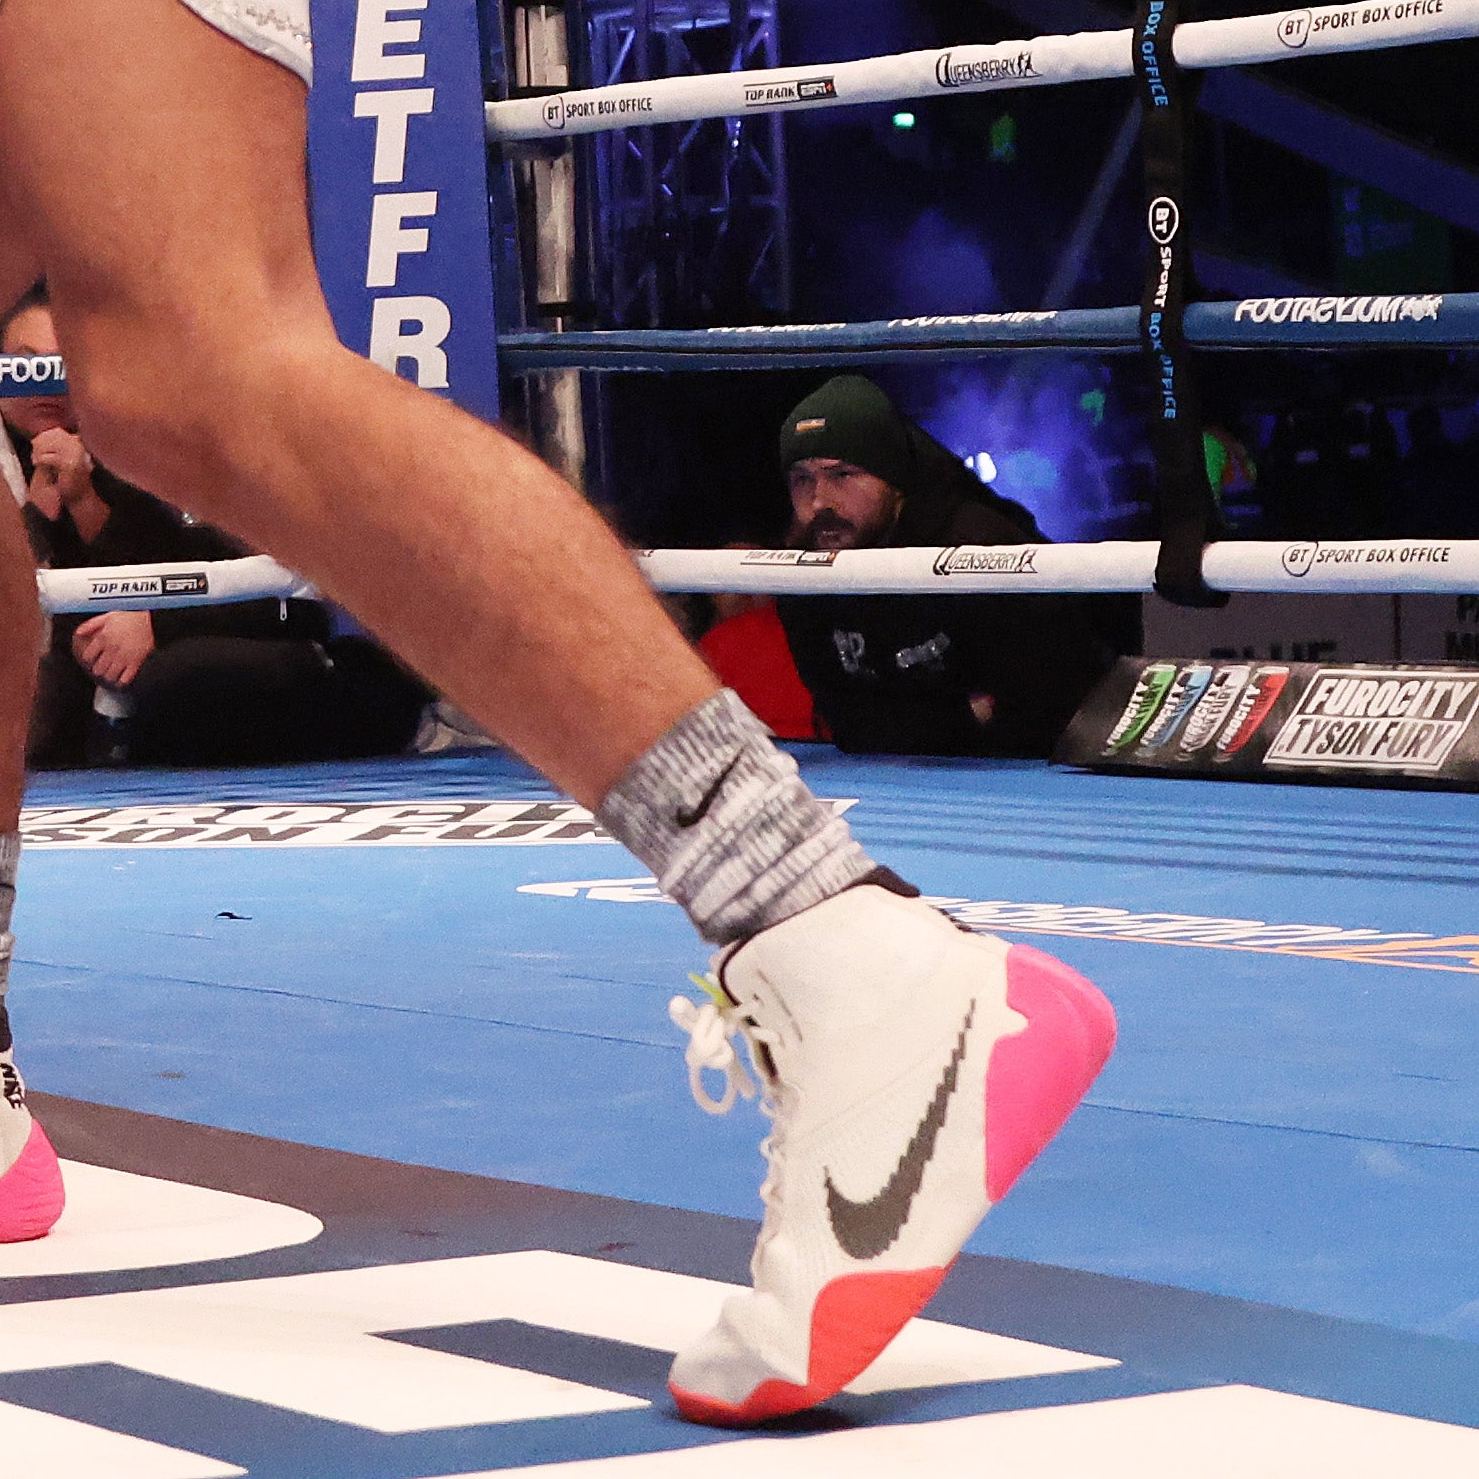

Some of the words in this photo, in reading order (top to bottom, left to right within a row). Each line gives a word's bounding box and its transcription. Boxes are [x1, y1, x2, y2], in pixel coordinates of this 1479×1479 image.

[1142, 0, 1164, 37] BOX
[1284, 19, 1304, 36] BT
[1312, 10, 1357, 33] SPORT
[1361, 4, 1392, 27] BOX
[935, 53, 1016, 88] QUEENSBERRY
[1142, 41, 1169, 107] OFFICE
[546, 105, 560, 122] BT
[566, 100, 595, 120] SPORT
[598, 100, 618, 117] BOX
[619, 97, 653, 116] OFFICE
[1155, 207, 1170, 234] BT
[1154, 246, 1172, 309] SPORT
[1235, 296, 1401, 323] FOOTASYLUM
[1148, 311, 1164, 352] BOX
[1288, 549, 1307, 564] BT
[1317, 548, 1364, 564] SPORT
[1366, 548, 1396, 563] BOX
[1400, 547, 1450, 563] OFFICE
[92, 582, 119, 595] TOP
[121, 580, 160, 594] RANK
[1304, 678, 1479, 719] FUROCITY
[1287, 720, 1381, 757] TYSON
[1374, 721, 1455, 759] FURY
[346, 820, 614, 842] FUR
